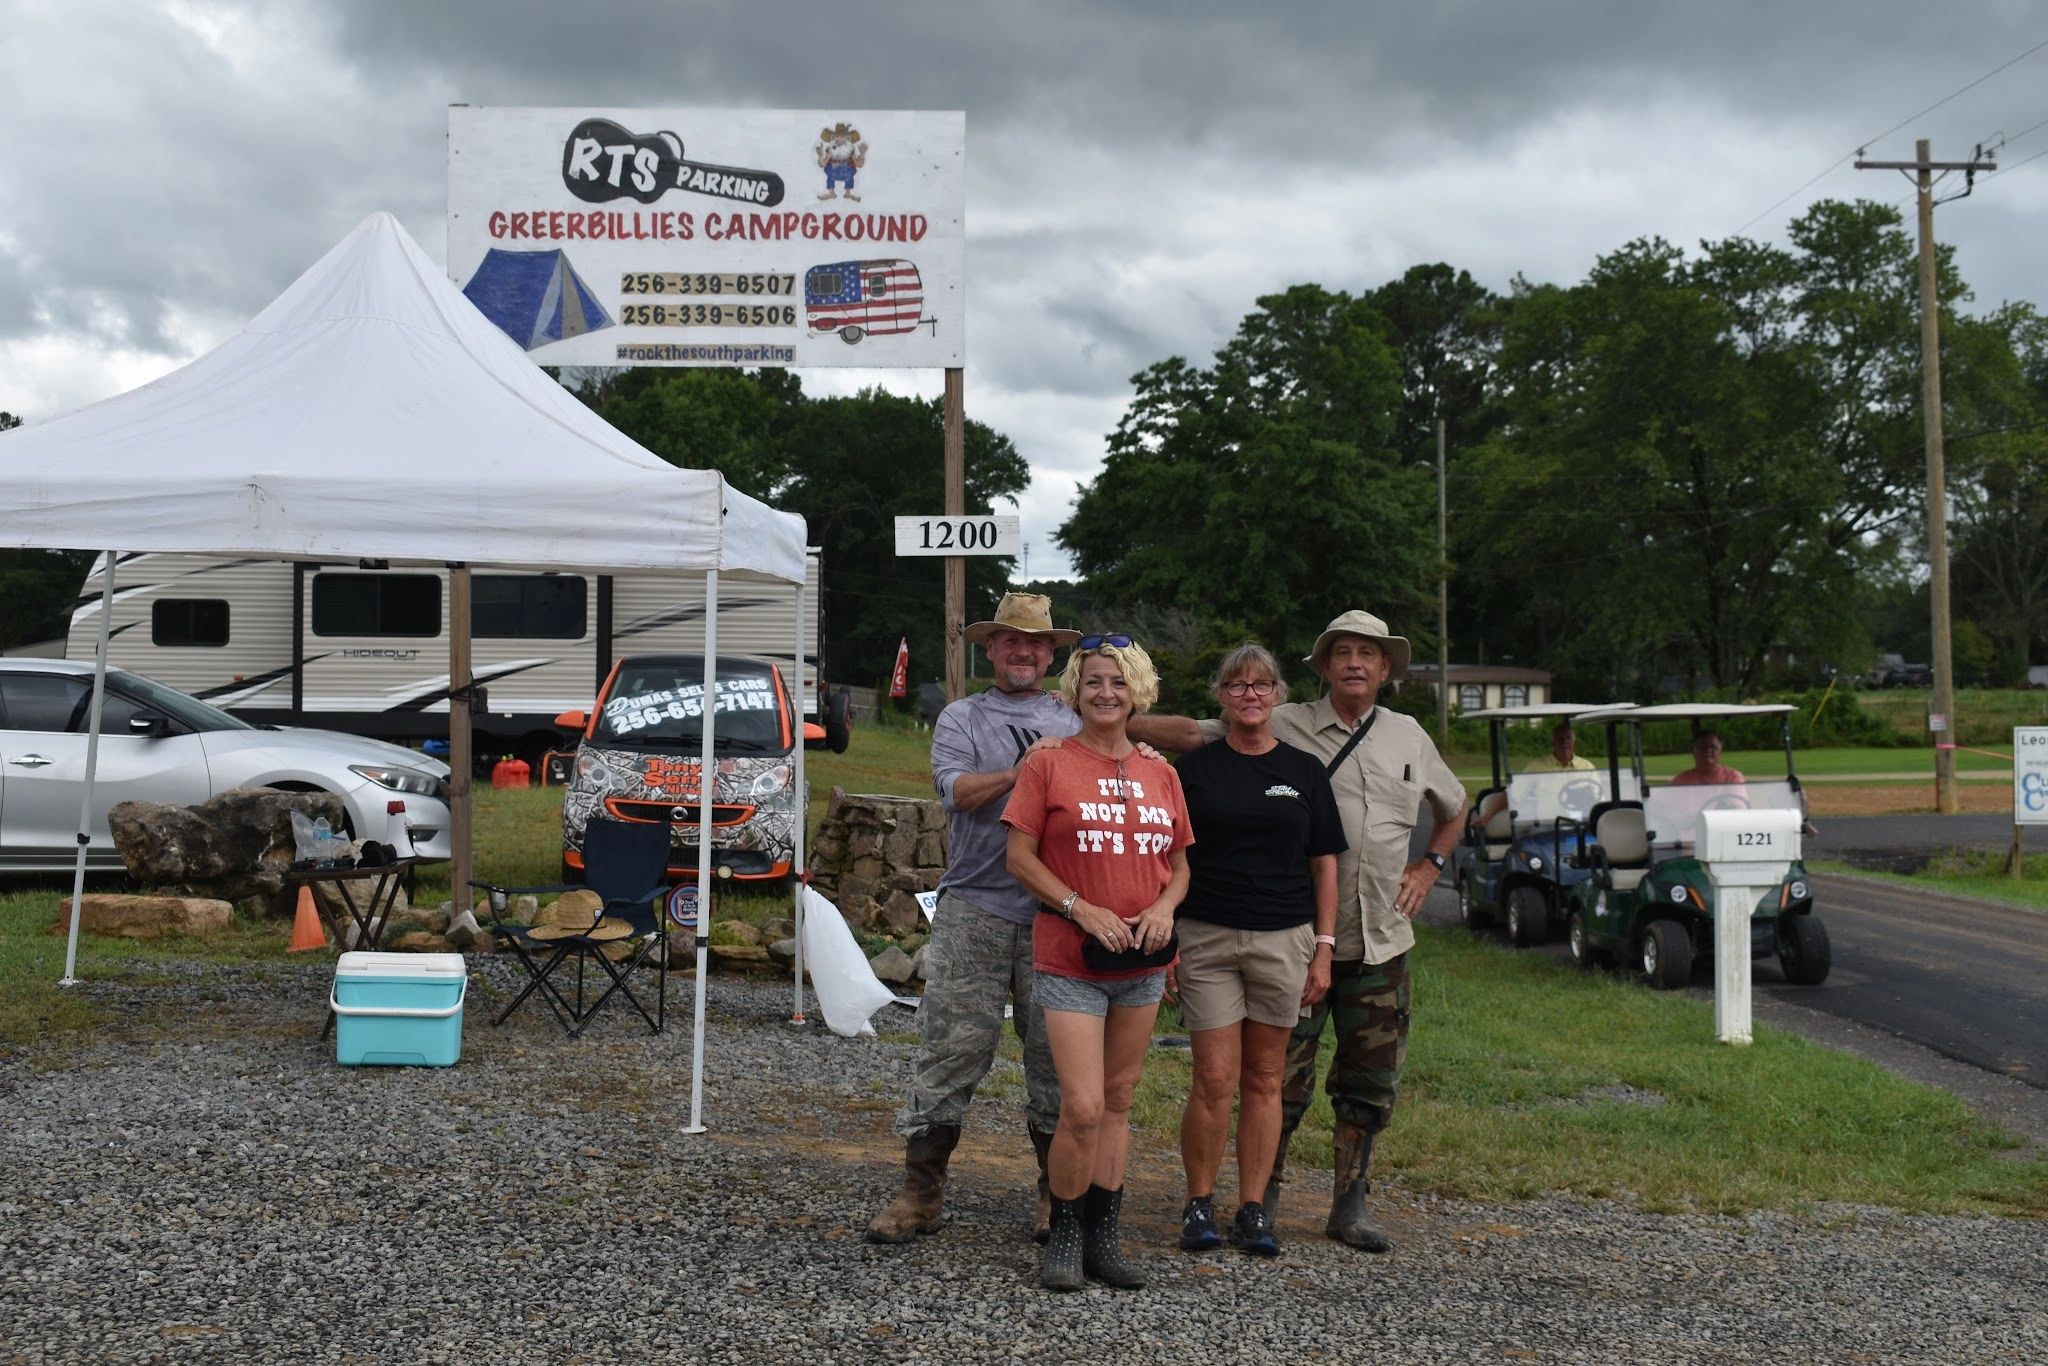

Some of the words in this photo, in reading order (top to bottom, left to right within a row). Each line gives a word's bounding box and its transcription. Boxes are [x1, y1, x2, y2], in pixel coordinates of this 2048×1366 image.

[569, 137, 659, 193] RTS
[676, 166, 769, 202] PARKING
[488, 211, 694, 241] GREERBILLIES
[704, 212, 928, 242] CAMPGROUND
[622, 273, 795, 295] 256-339-6507
[623, 304, 796, 326] 256-339-6506
[616, 344, 794, 362] #rockthesouthparking
[919, 521, 998, 549] 1200
[343, 649, 421, 657] HIDEOUT
[677, 682, 724, 698] SELS
[728, 679, 769, 692] CARS
[2021, 735, 2048, 746] Leo
[645, 758, 703, 775] Tony
[643, 771, 717, 787] Serr
[1097, 779, 1145, 798] IT'S
[1079, 802, 1127, 824] NOT
[1137, 805, 1172, 827] ME
[1076, 830, 1125, 854] IT'S
[1736, 832, 1772, 846] 1221
